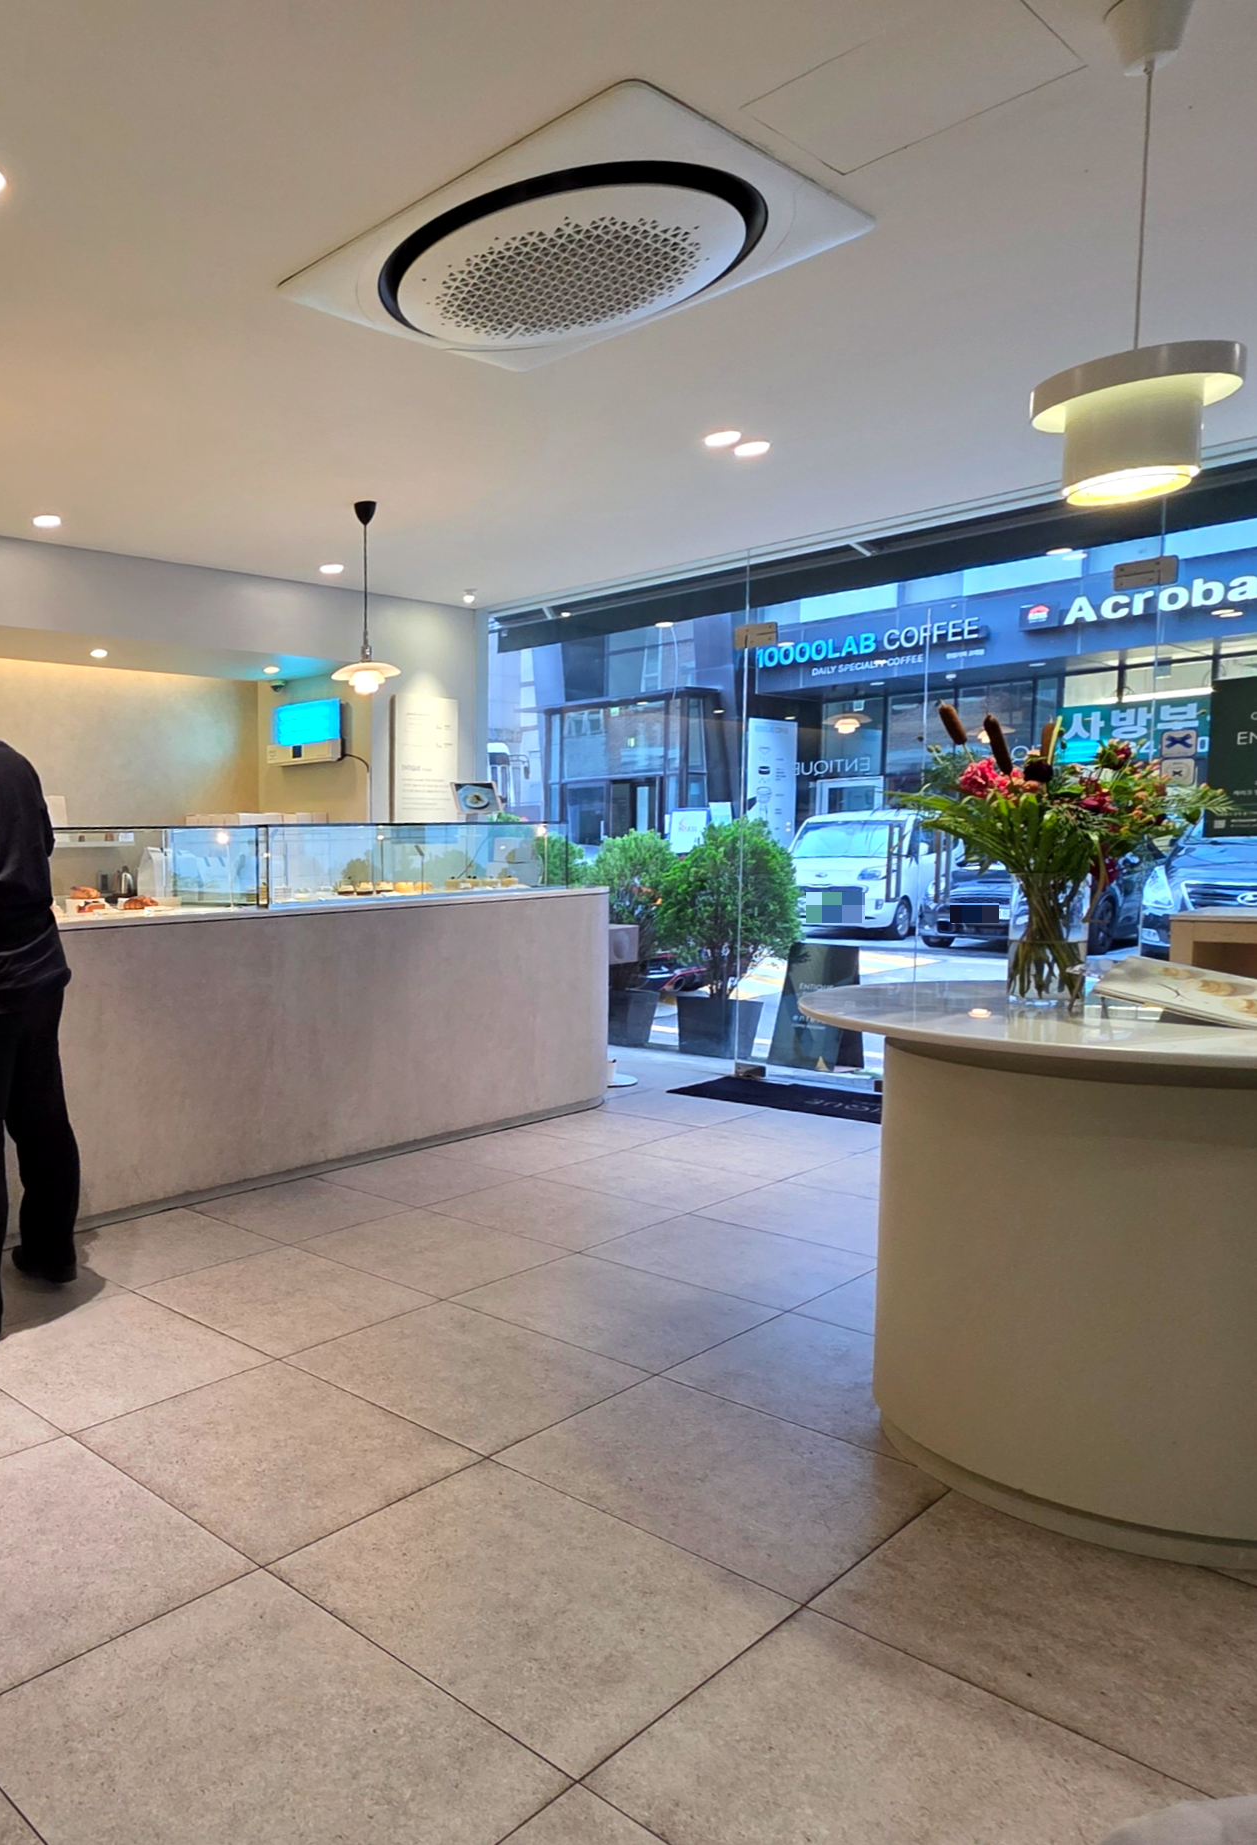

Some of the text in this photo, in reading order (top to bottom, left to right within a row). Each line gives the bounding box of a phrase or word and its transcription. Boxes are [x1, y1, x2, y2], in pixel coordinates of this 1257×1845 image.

[756, 617, 980, 668] 10000LAB COFFEE
[811, 664, 837, 677] DAILY
[887, 654, 924, 667] COFFEE
[1063, 702, 1210, 741] 사방부
